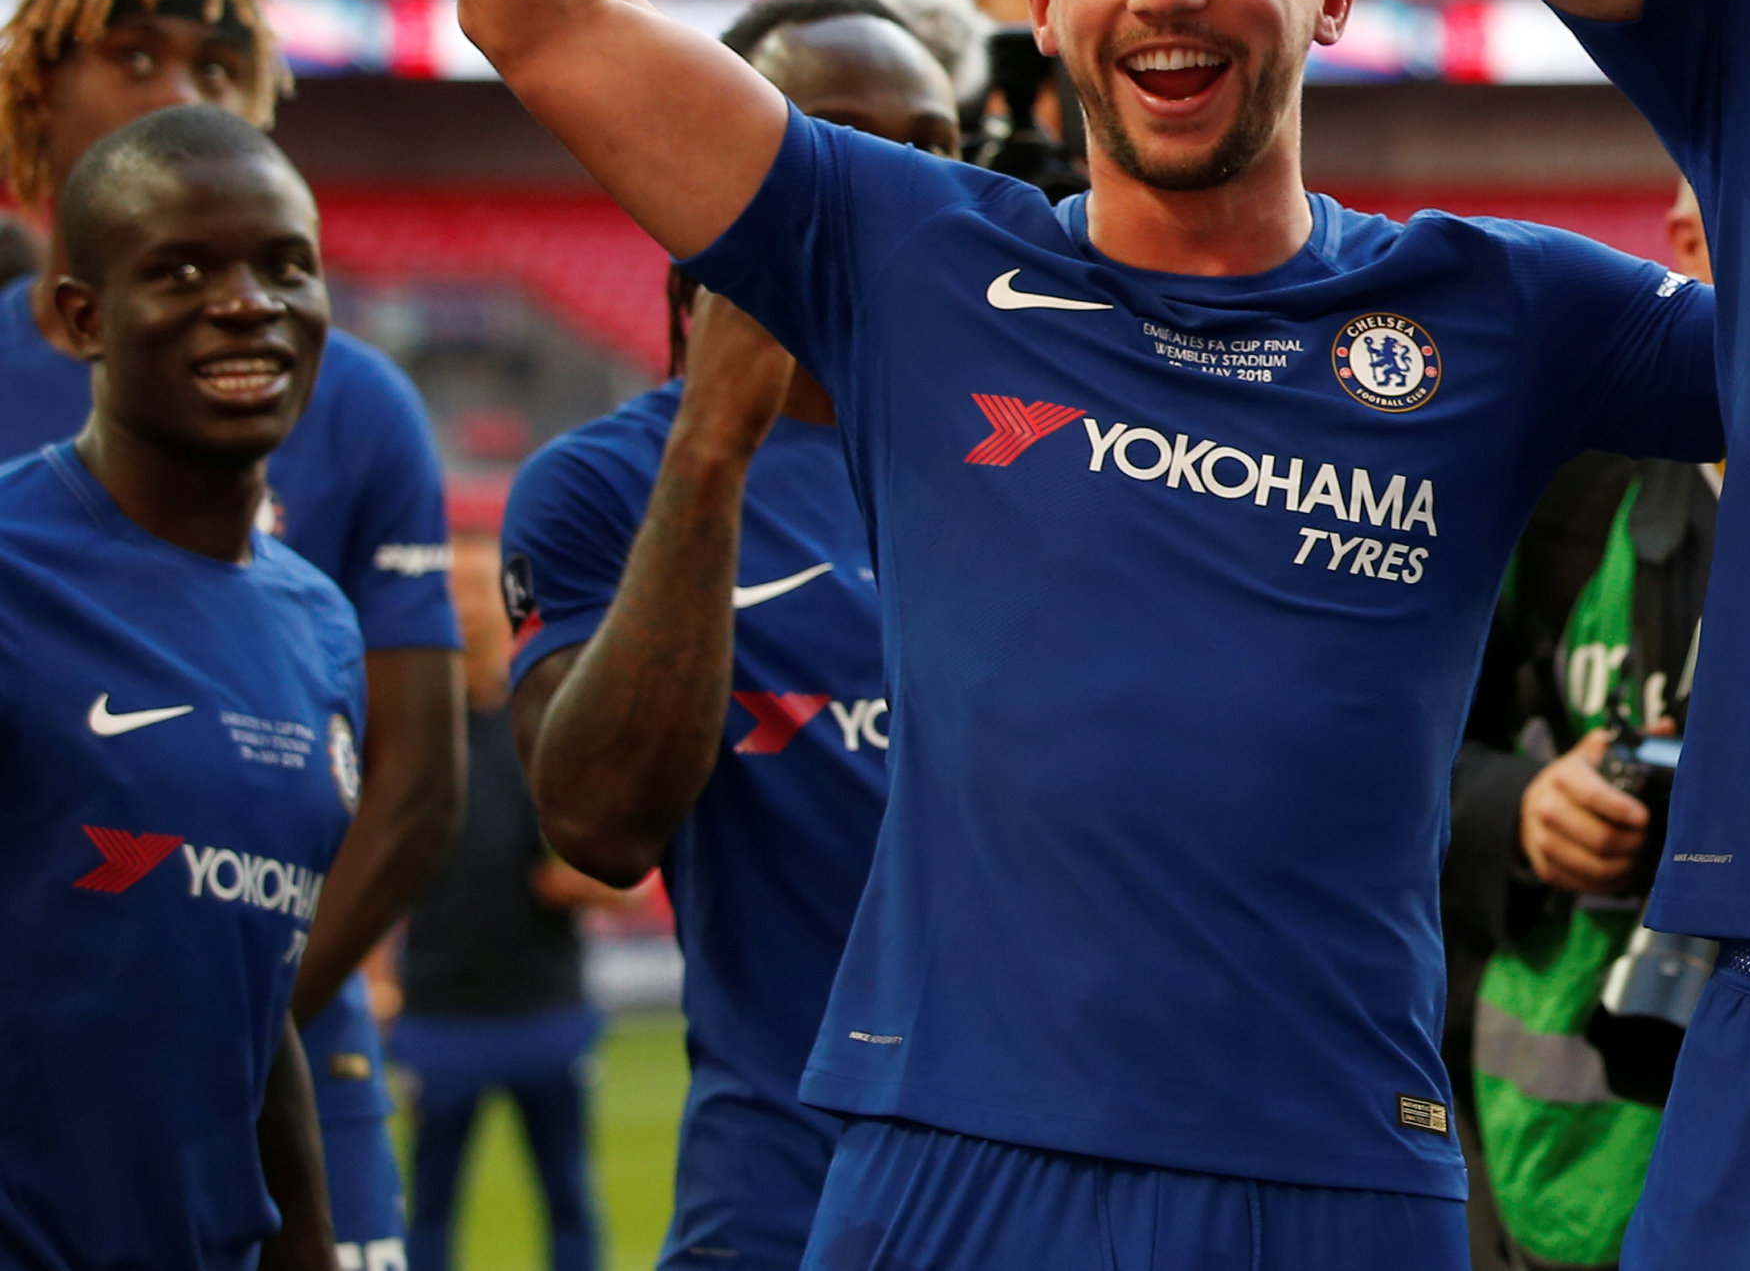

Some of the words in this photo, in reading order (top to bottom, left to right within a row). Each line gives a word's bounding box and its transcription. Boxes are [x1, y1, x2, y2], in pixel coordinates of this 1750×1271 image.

[1143, 322, 1204, 349] EMIRATES
[1207, 340, 1226, 352] FA
[1230, 340, 1261, 352] CUP
[1263, 339, 1304, 352] FINAL
[1346, 316, 1415, 338] CHELSEA
[1154, 341, 1218, 365] WEMBLEY
[1222, 354, 1287, 368] STADIUM
[1236, 369, 1272, 383] 2018
[1356, 388, 1404, 407] FOOTBALL
[1405, 387, 1427, 404] CLUB
[1083, 418, 1437, 537] YOKOHAMA
[1293, 527, 1429, 584] TYRES
